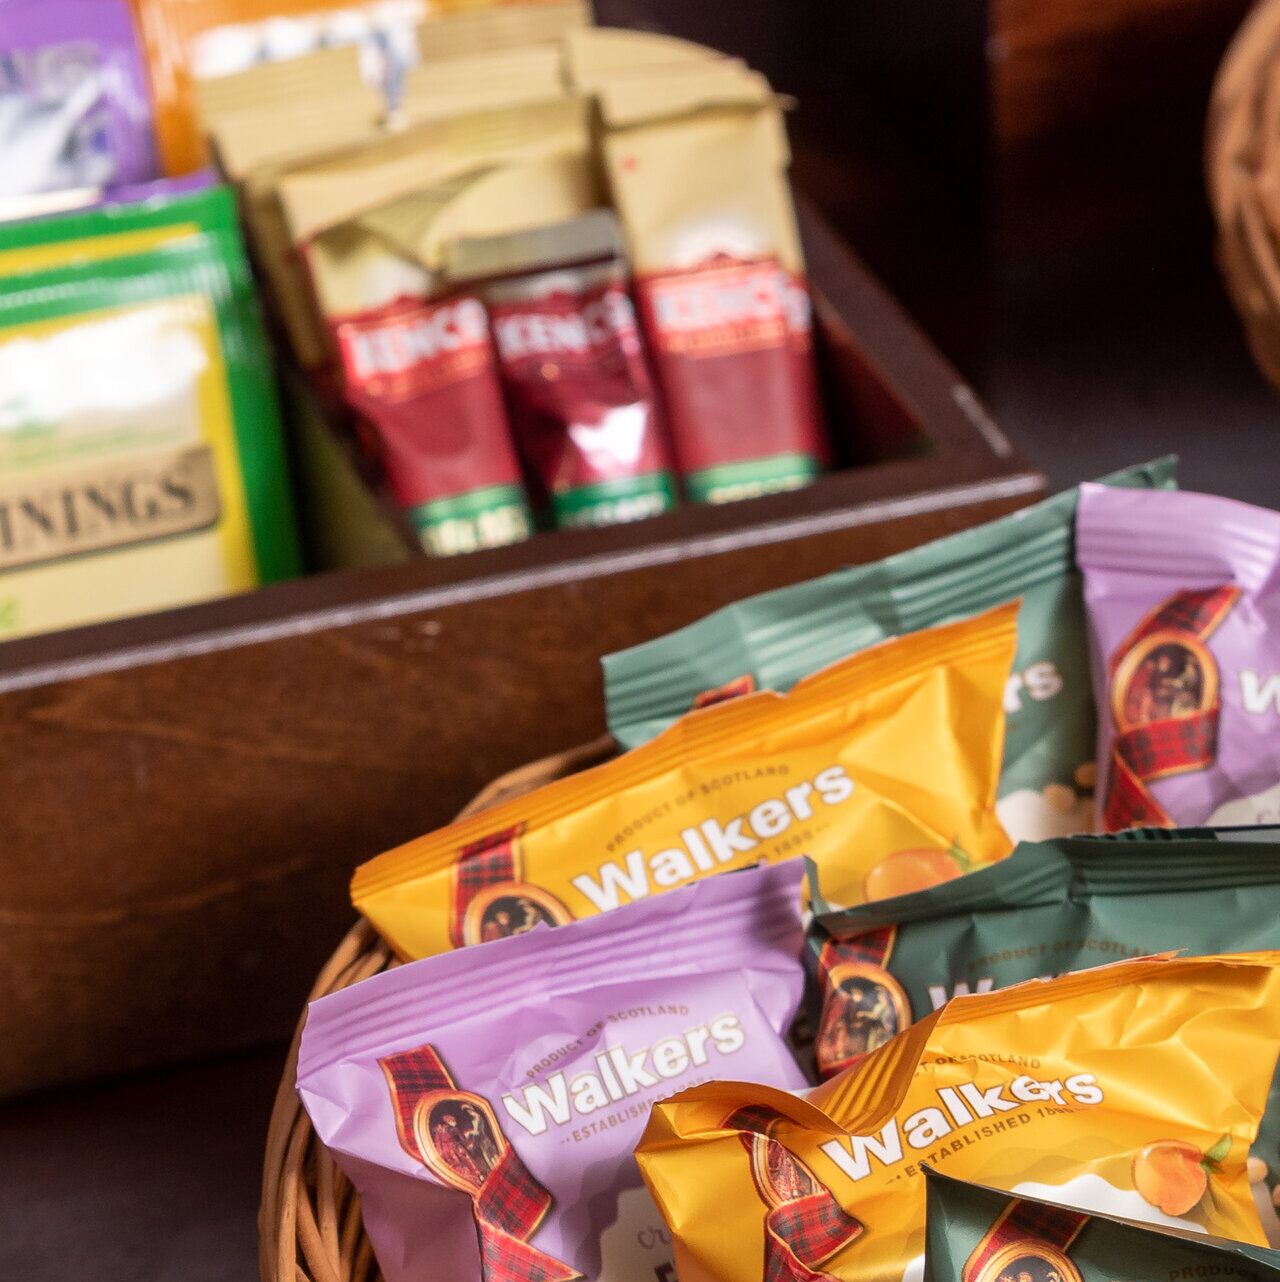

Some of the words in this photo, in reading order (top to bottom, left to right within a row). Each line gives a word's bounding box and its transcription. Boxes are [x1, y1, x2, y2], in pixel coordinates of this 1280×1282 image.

[571, 764, 857, 914] Walkers
[500, 1011, 747, 1137] Walkers
[525, 1039, 586, 1080] PRODUCT
[607, 1003, 690, 1024] SCOTLAND
[819, 1073, 1105, 1182] Walkers
[907, 1111, 1032, 1178] ESTABLISHED
